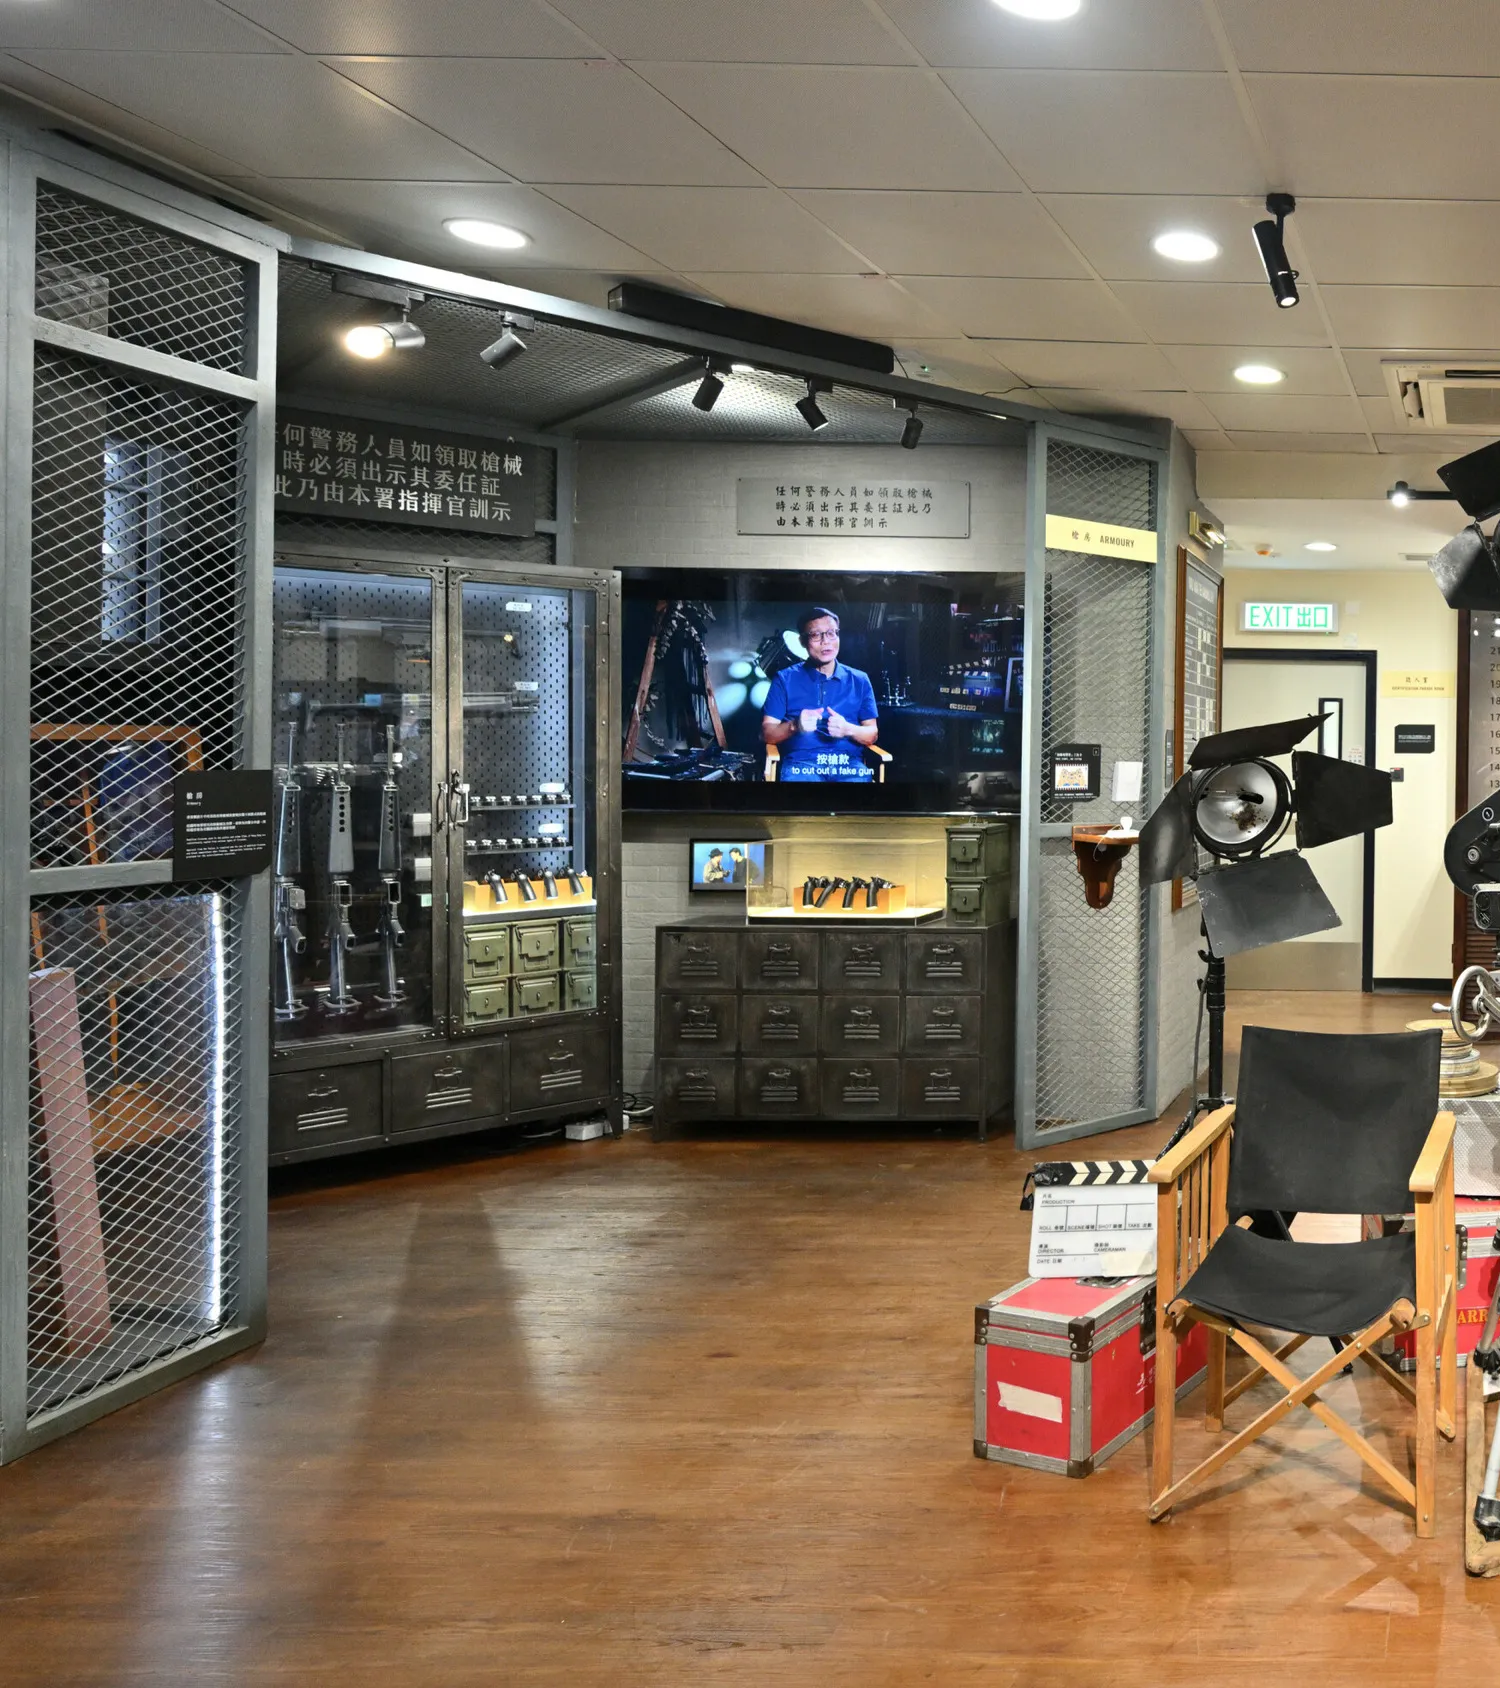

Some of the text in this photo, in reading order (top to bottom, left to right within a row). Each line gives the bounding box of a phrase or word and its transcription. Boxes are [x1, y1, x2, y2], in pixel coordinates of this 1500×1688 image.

[283, 449, 501, 497] 時必須出示其委任証
[776, 486, 933, 500] 任何警務人員如領取槍械
[776, 502, 931, 514] 時必須出示其委任証此乃
[776, 517, 888, 529] 由本署指揮官訓示
[1099, 535, 1135, 549] ARMOURY
[1250, 606, 1328, 627] EXIT 出口
[802, 767, 815, 775] cut
[817, 767, 830, 775] out
[839, 767, 857, 775] fake
